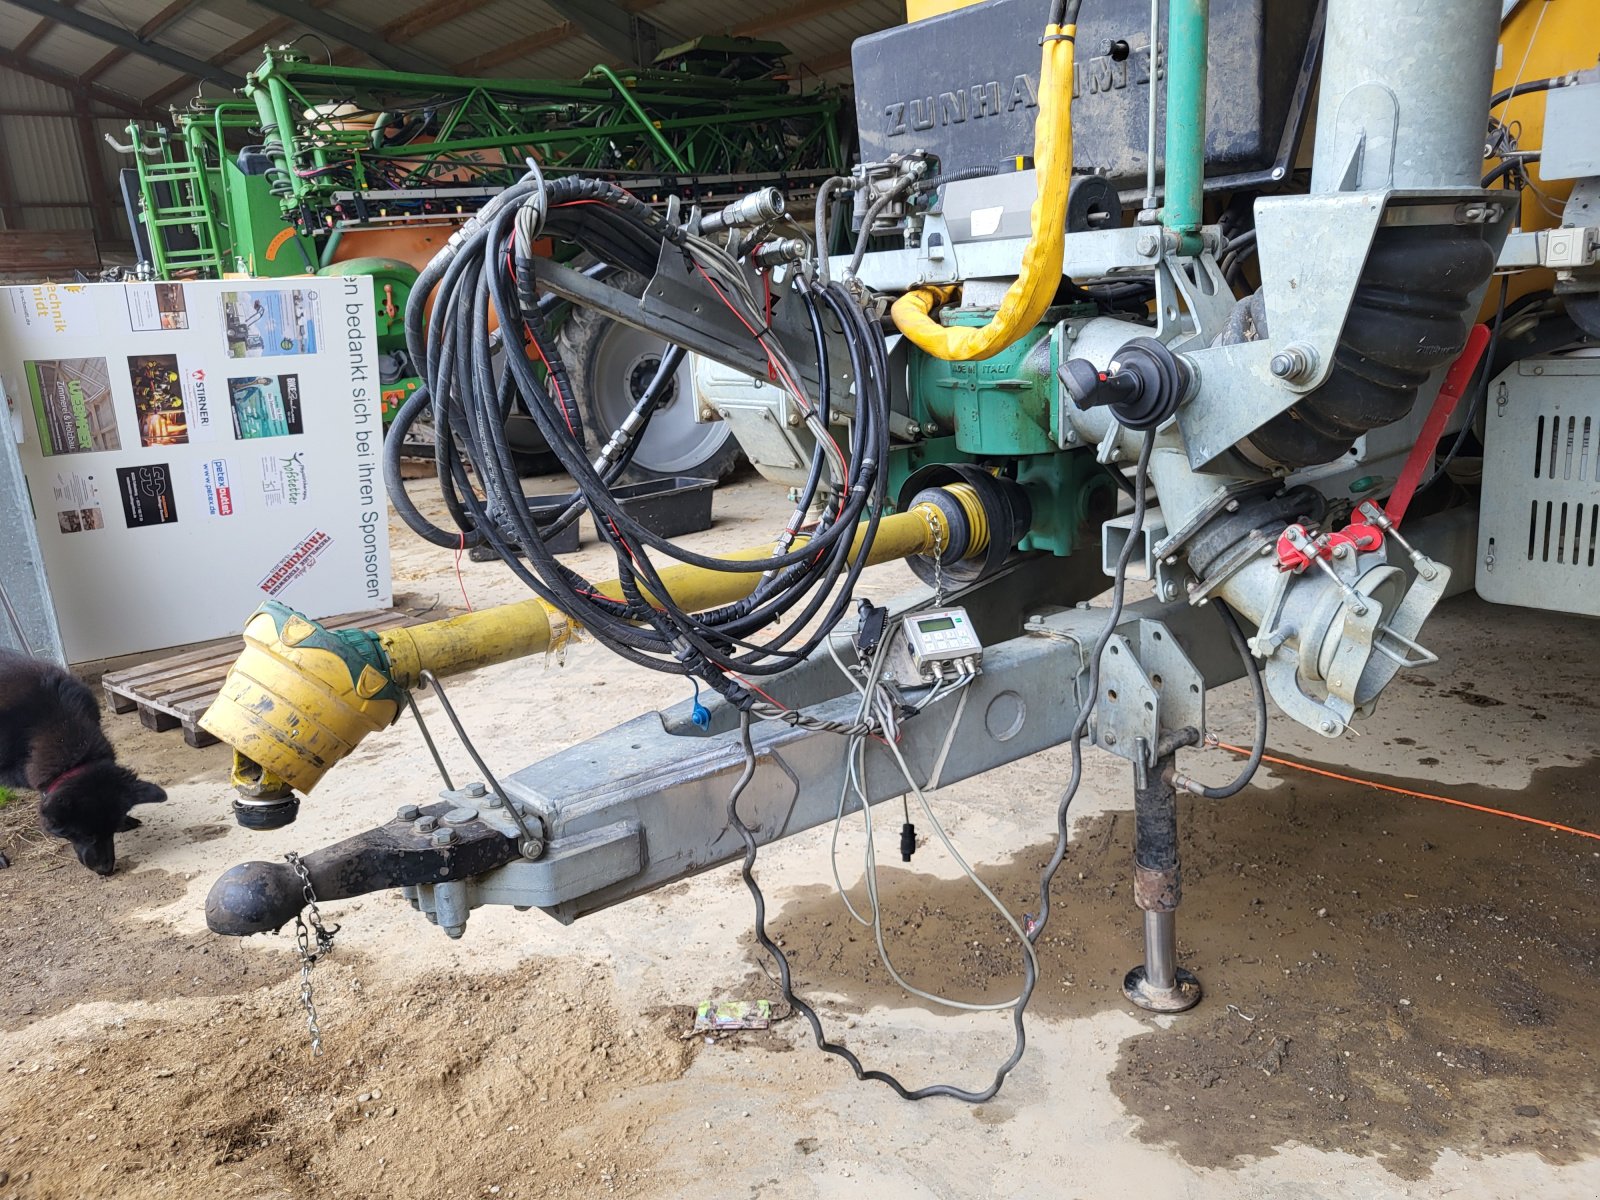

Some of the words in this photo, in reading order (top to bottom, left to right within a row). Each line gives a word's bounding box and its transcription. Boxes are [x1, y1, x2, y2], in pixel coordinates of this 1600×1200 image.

[884, 44, 1166, 137] ZUNHAME
[345, 303, 368, 382] bedankt
[196, 382, 209, 424] STIRNER
[352, 388, 372, 424] sich
[65, 421, 75, 449] Holzbau
[355, 431, 374, 457] bei
[203, 463, 216, 515] www.petex.de
[213, 461, 225, 487] petex
[358, 463, 375, 506] ihren
[218, 488, 231, 515] outlet
[261, 531, 326, 592] TAUFKIRCHEN
[358, 511, 379, 599] Sponsoren
